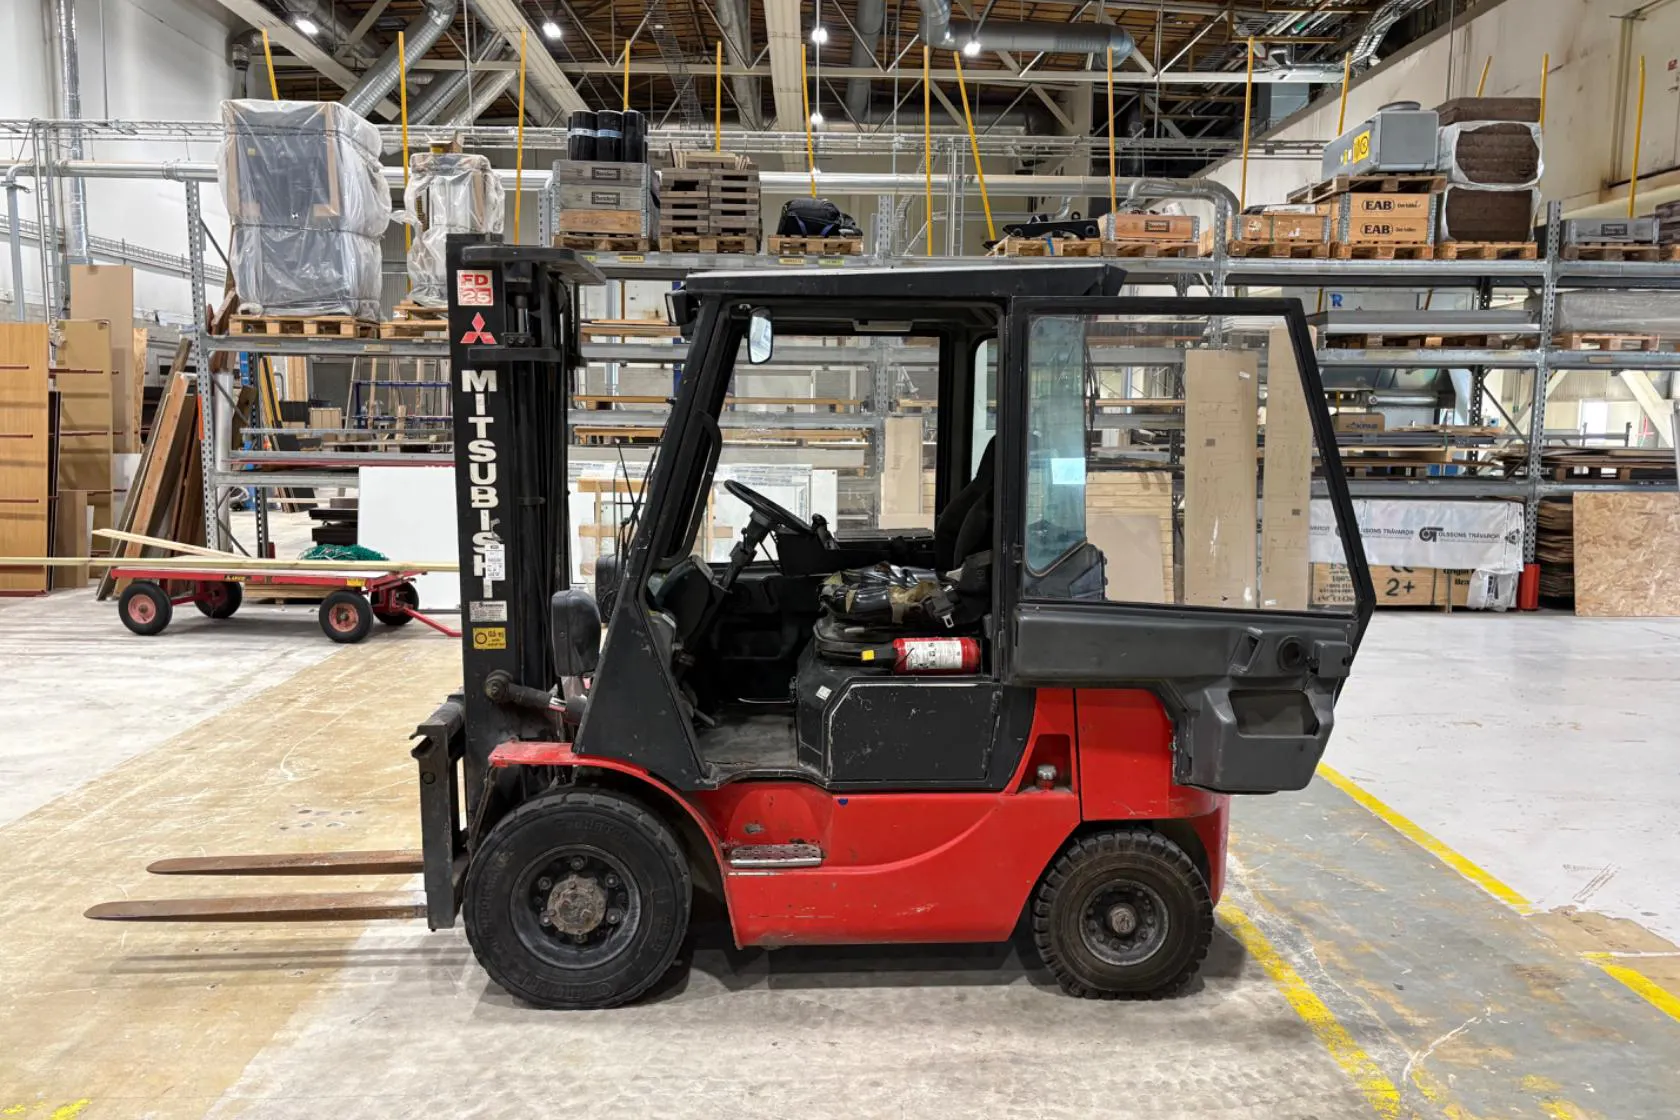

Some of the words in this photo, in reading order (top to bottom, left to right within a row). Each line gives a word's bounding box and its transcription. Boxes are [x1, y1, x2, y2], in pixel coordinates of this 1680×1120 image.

[1365, 200, 1392, 210] EAB
[1364, 225, 1390, 234] EAB
[461, 274, 489, 286] FD
[462, 290, 491, 304] 25
[1386, 577, 1415, 597] 2+
